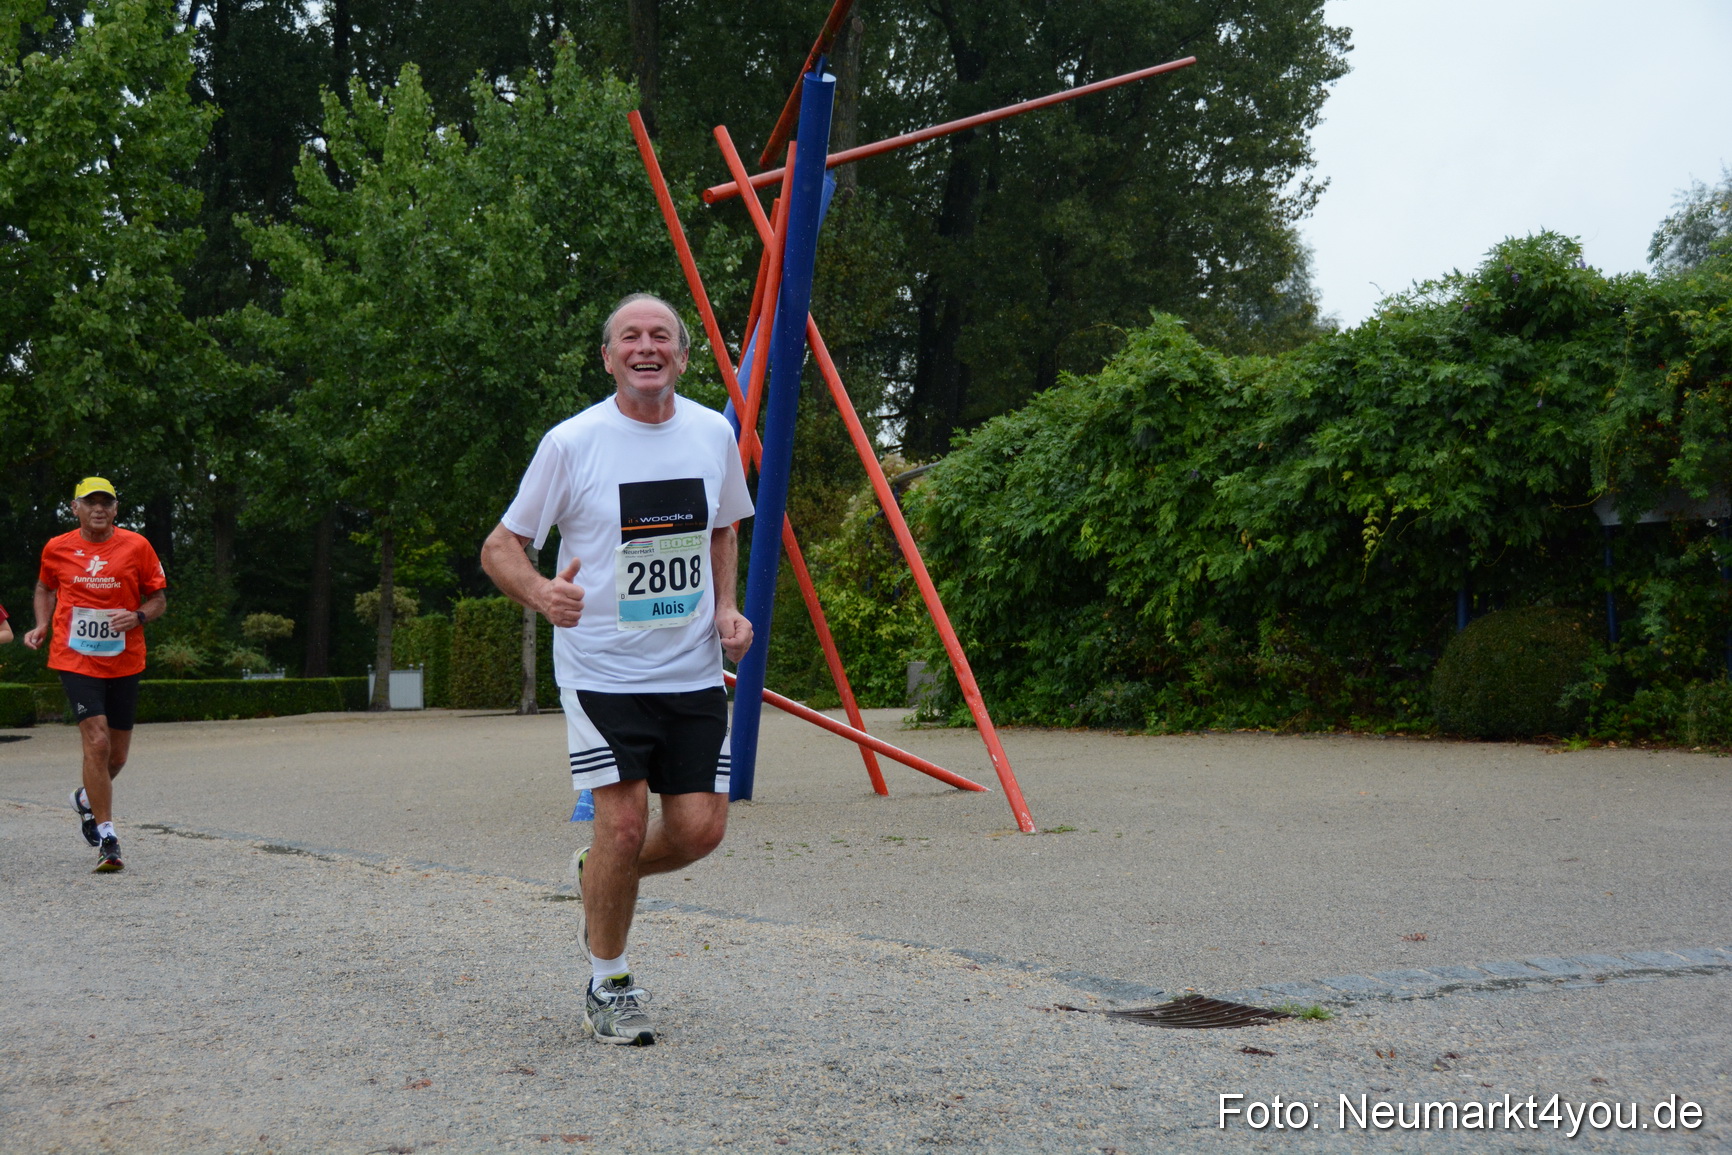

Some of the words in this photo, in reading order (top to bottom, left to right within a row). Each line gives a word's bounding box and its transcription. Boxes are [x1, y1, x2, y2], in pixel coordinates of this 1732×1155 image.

[640, 513, 693, 523] woodka
[660, 535, 703, 550] BOCK
[73, 575, 115, 583] funrunners
[627, 554, 701, 596] 2808
[86, 581, 121, 589] neumarkt
[652, 600, 685, 616] Alois
